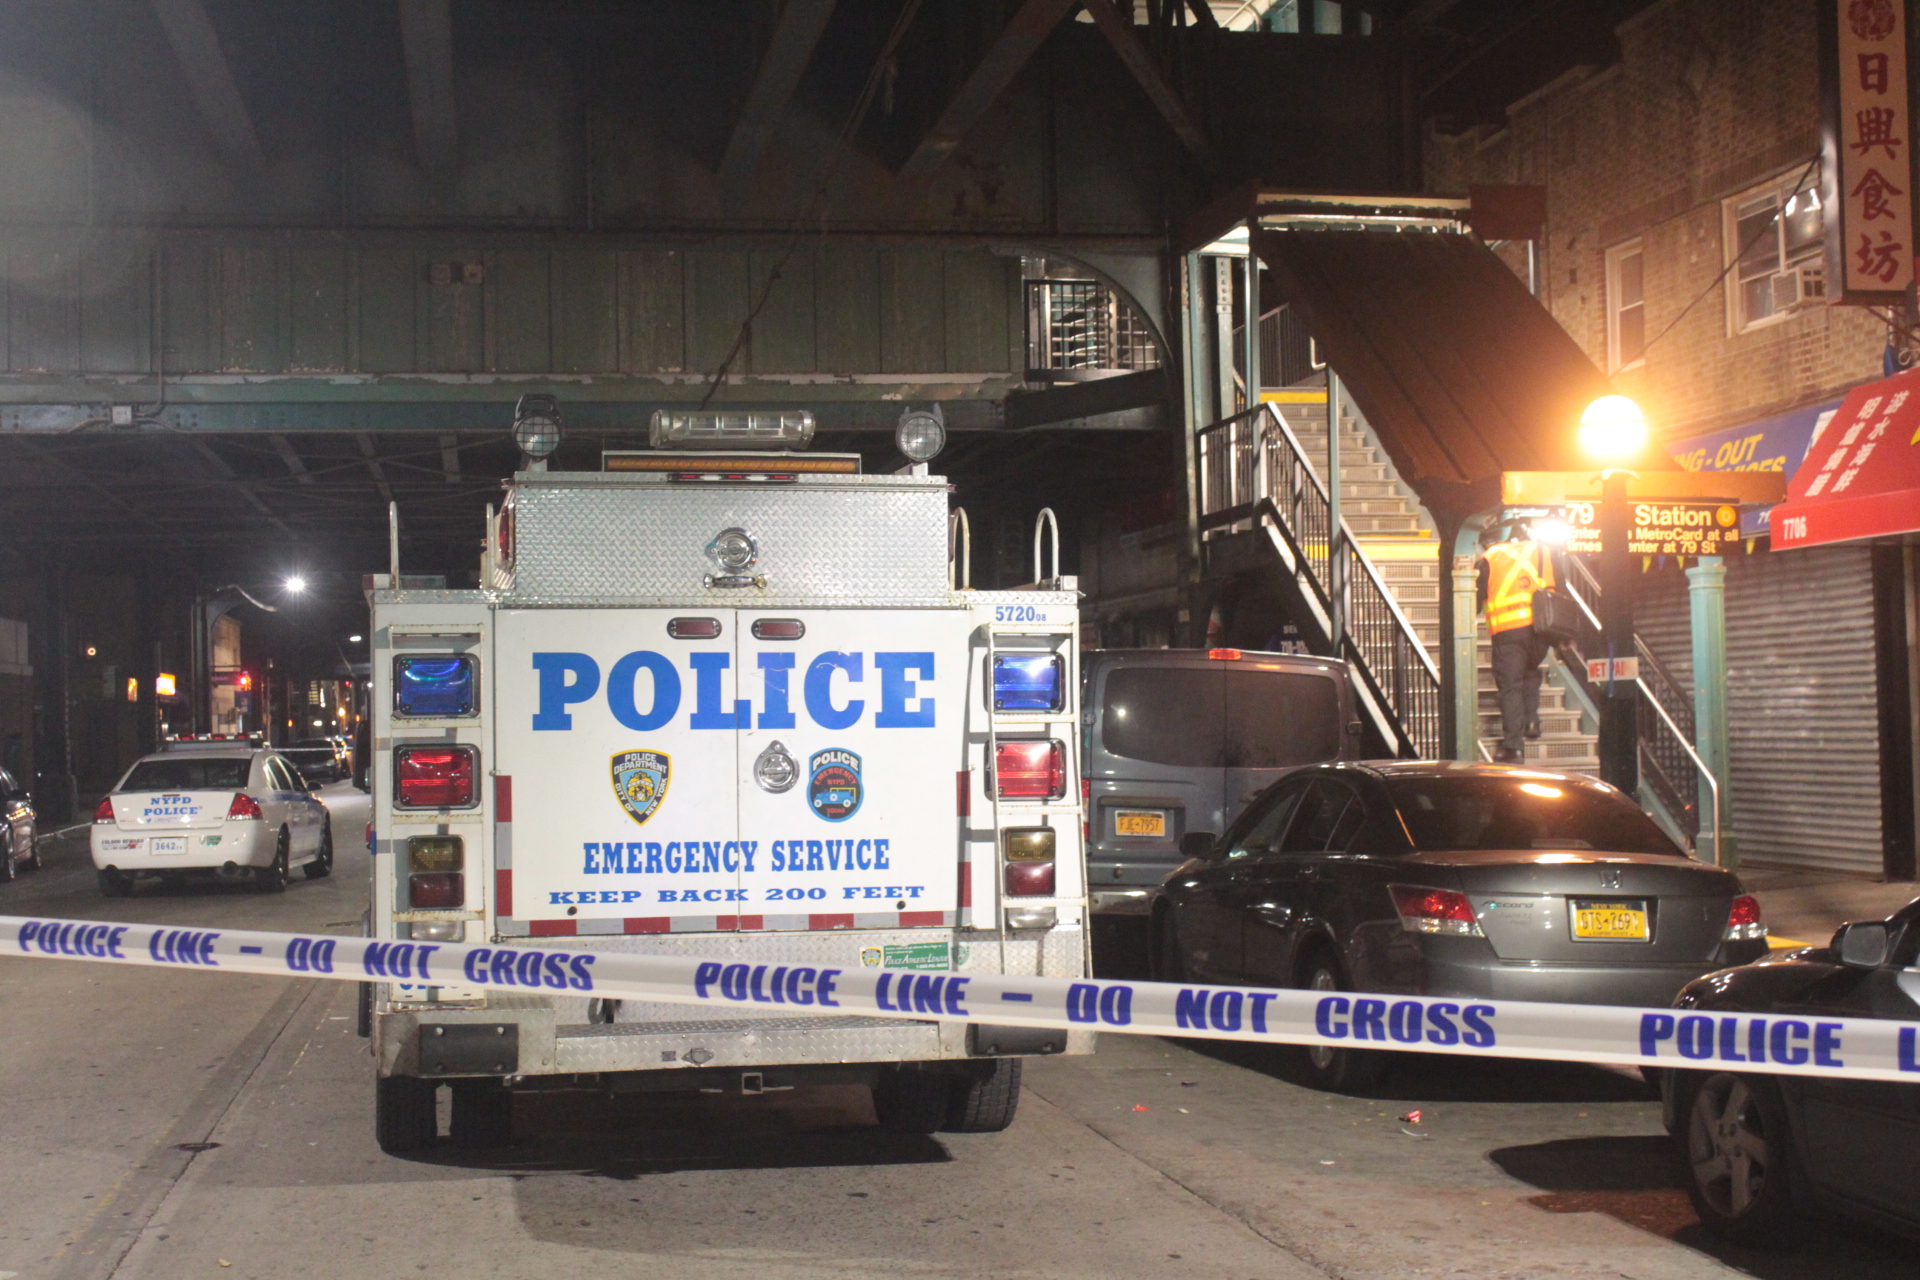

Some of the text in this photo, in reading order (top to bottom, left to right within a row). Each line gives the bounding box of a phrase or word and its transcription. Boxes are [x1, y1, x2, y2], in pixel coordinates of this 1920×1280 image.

[1849, 52, 1903, 283] 日興食坊
[1566, 503, 1595, 525] 79
[1635, 504, 1712, 526] Station
[1636, 527, 1703, 541] MetroCard
[1707, 530, 1720, 541] at
[1725, 528, 1739, 541] all
[1783, 516, 1807, 540] 7706
[1663, 542, 1676, 554] at
[1681, 541, 1698, 554] 79
[1701, 541, 1716, 554] St
[995, 606, 1035, 622] 5720
[532, 650, 936, 731] POLICE
[613, 760, 667, 775] DEPARTMENT
[624, 752, 657, 763] POLICE
[812, 751, 859, 772] POLICE
[814, 767, 857, 785] EMERGENCY
[150, 797, 192, 806] NYPD
[614, 777, 668, 816] CITY OF NEW YORK
[144, 807, 199, 816] POLICE
[583, 838, 890, 874] EMERGENCY SERVICE
[549, 885, 925, 904] KEEP BACK 200 FEET
[18, 921, 129, 959] POLICE
[150, 929, 221, 966] LINE
[286, 938, 336, 973] DO
[363, 942, 441, 980] NOT
[464, 948, 595, 991] CROSS
[694, 962, 842, 1007] POLICE
[876, 973, 971, 1015] LINE
[1066, 983, 1133, 1026] DO
[1175, 989, 1278, 1034] NOT
[1315, 997, 1496, 1048] CROSS
[1640, 1013, 1844, 1068] POLICE
